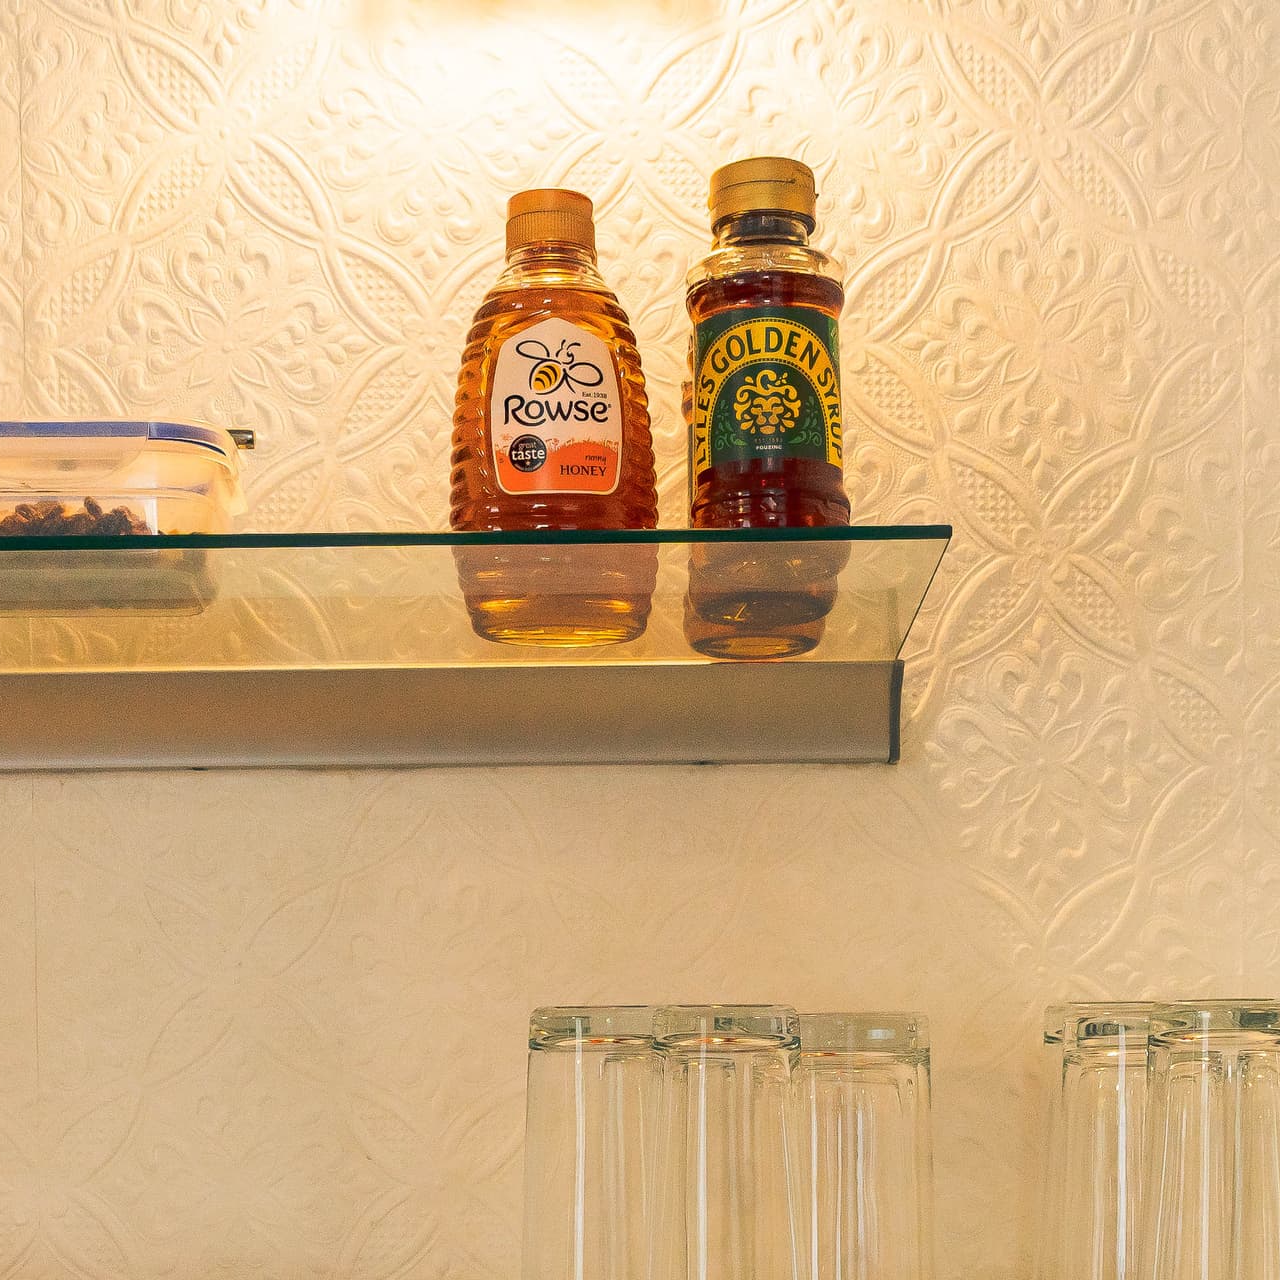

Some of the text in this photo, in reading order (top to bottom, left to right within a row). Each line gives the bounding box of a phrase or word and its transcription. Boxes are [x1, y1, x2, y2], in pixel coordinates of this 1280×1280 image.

[710, 327, 821, 374] GOLDEN
[817, 367, 842, 459] SYRUP
[504, 395, 609, 426] Rowse
[511, 448, 546, 460] taste
[560, 465, 607, 476] HONEY
